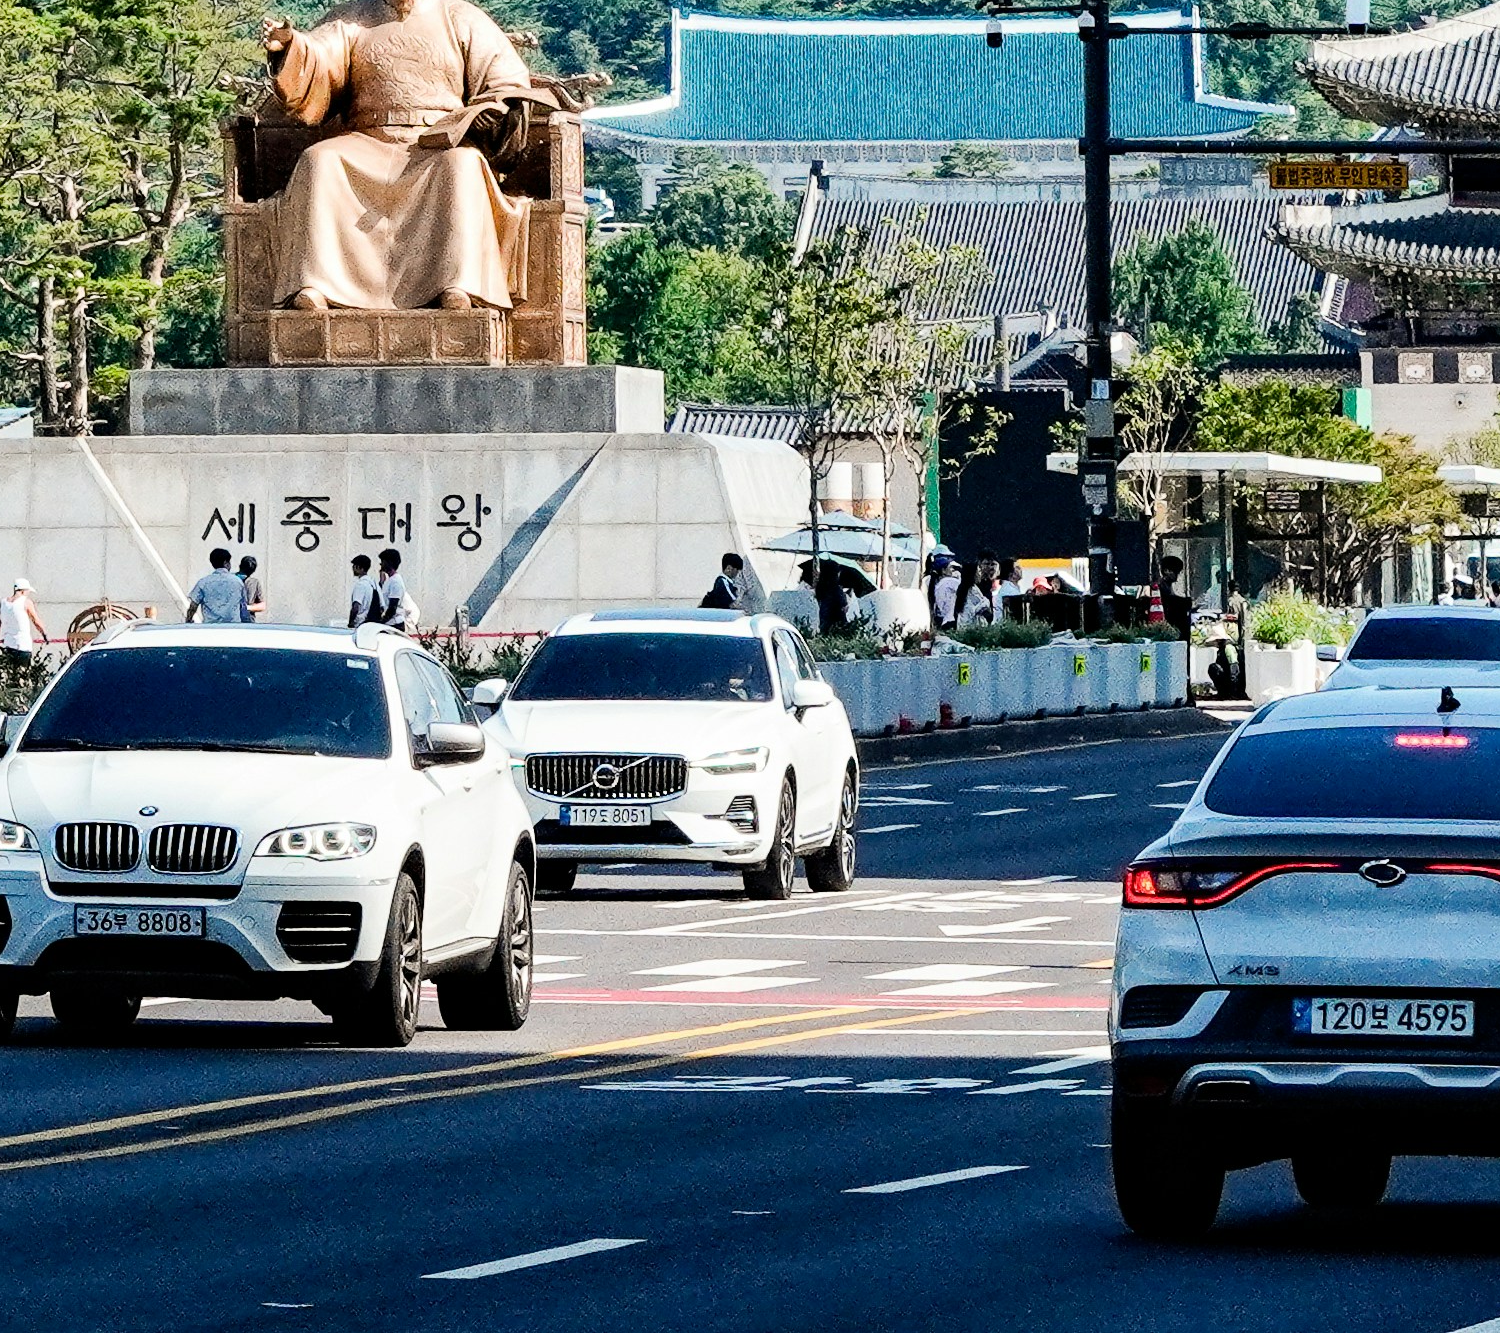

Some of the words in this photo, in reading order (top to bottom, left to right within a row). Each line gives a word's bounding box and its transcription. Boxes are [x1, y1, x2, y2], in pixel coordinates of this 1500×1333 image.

[1339, 166, 1363, 185] 무인
[1367, 165, 1403, 186] 단속중
[200, 493, 493, 553] 세종대왕
[572, 808, 609, 823] 119도
[612, 808, 646, 823] 8051
[87, 911, 128, 932] 36부
[137, 912, 192, 933] 8808
[1316, 1001, 1390, 1031] 120보
[1396, 1002, 1468, 1032] 4595
